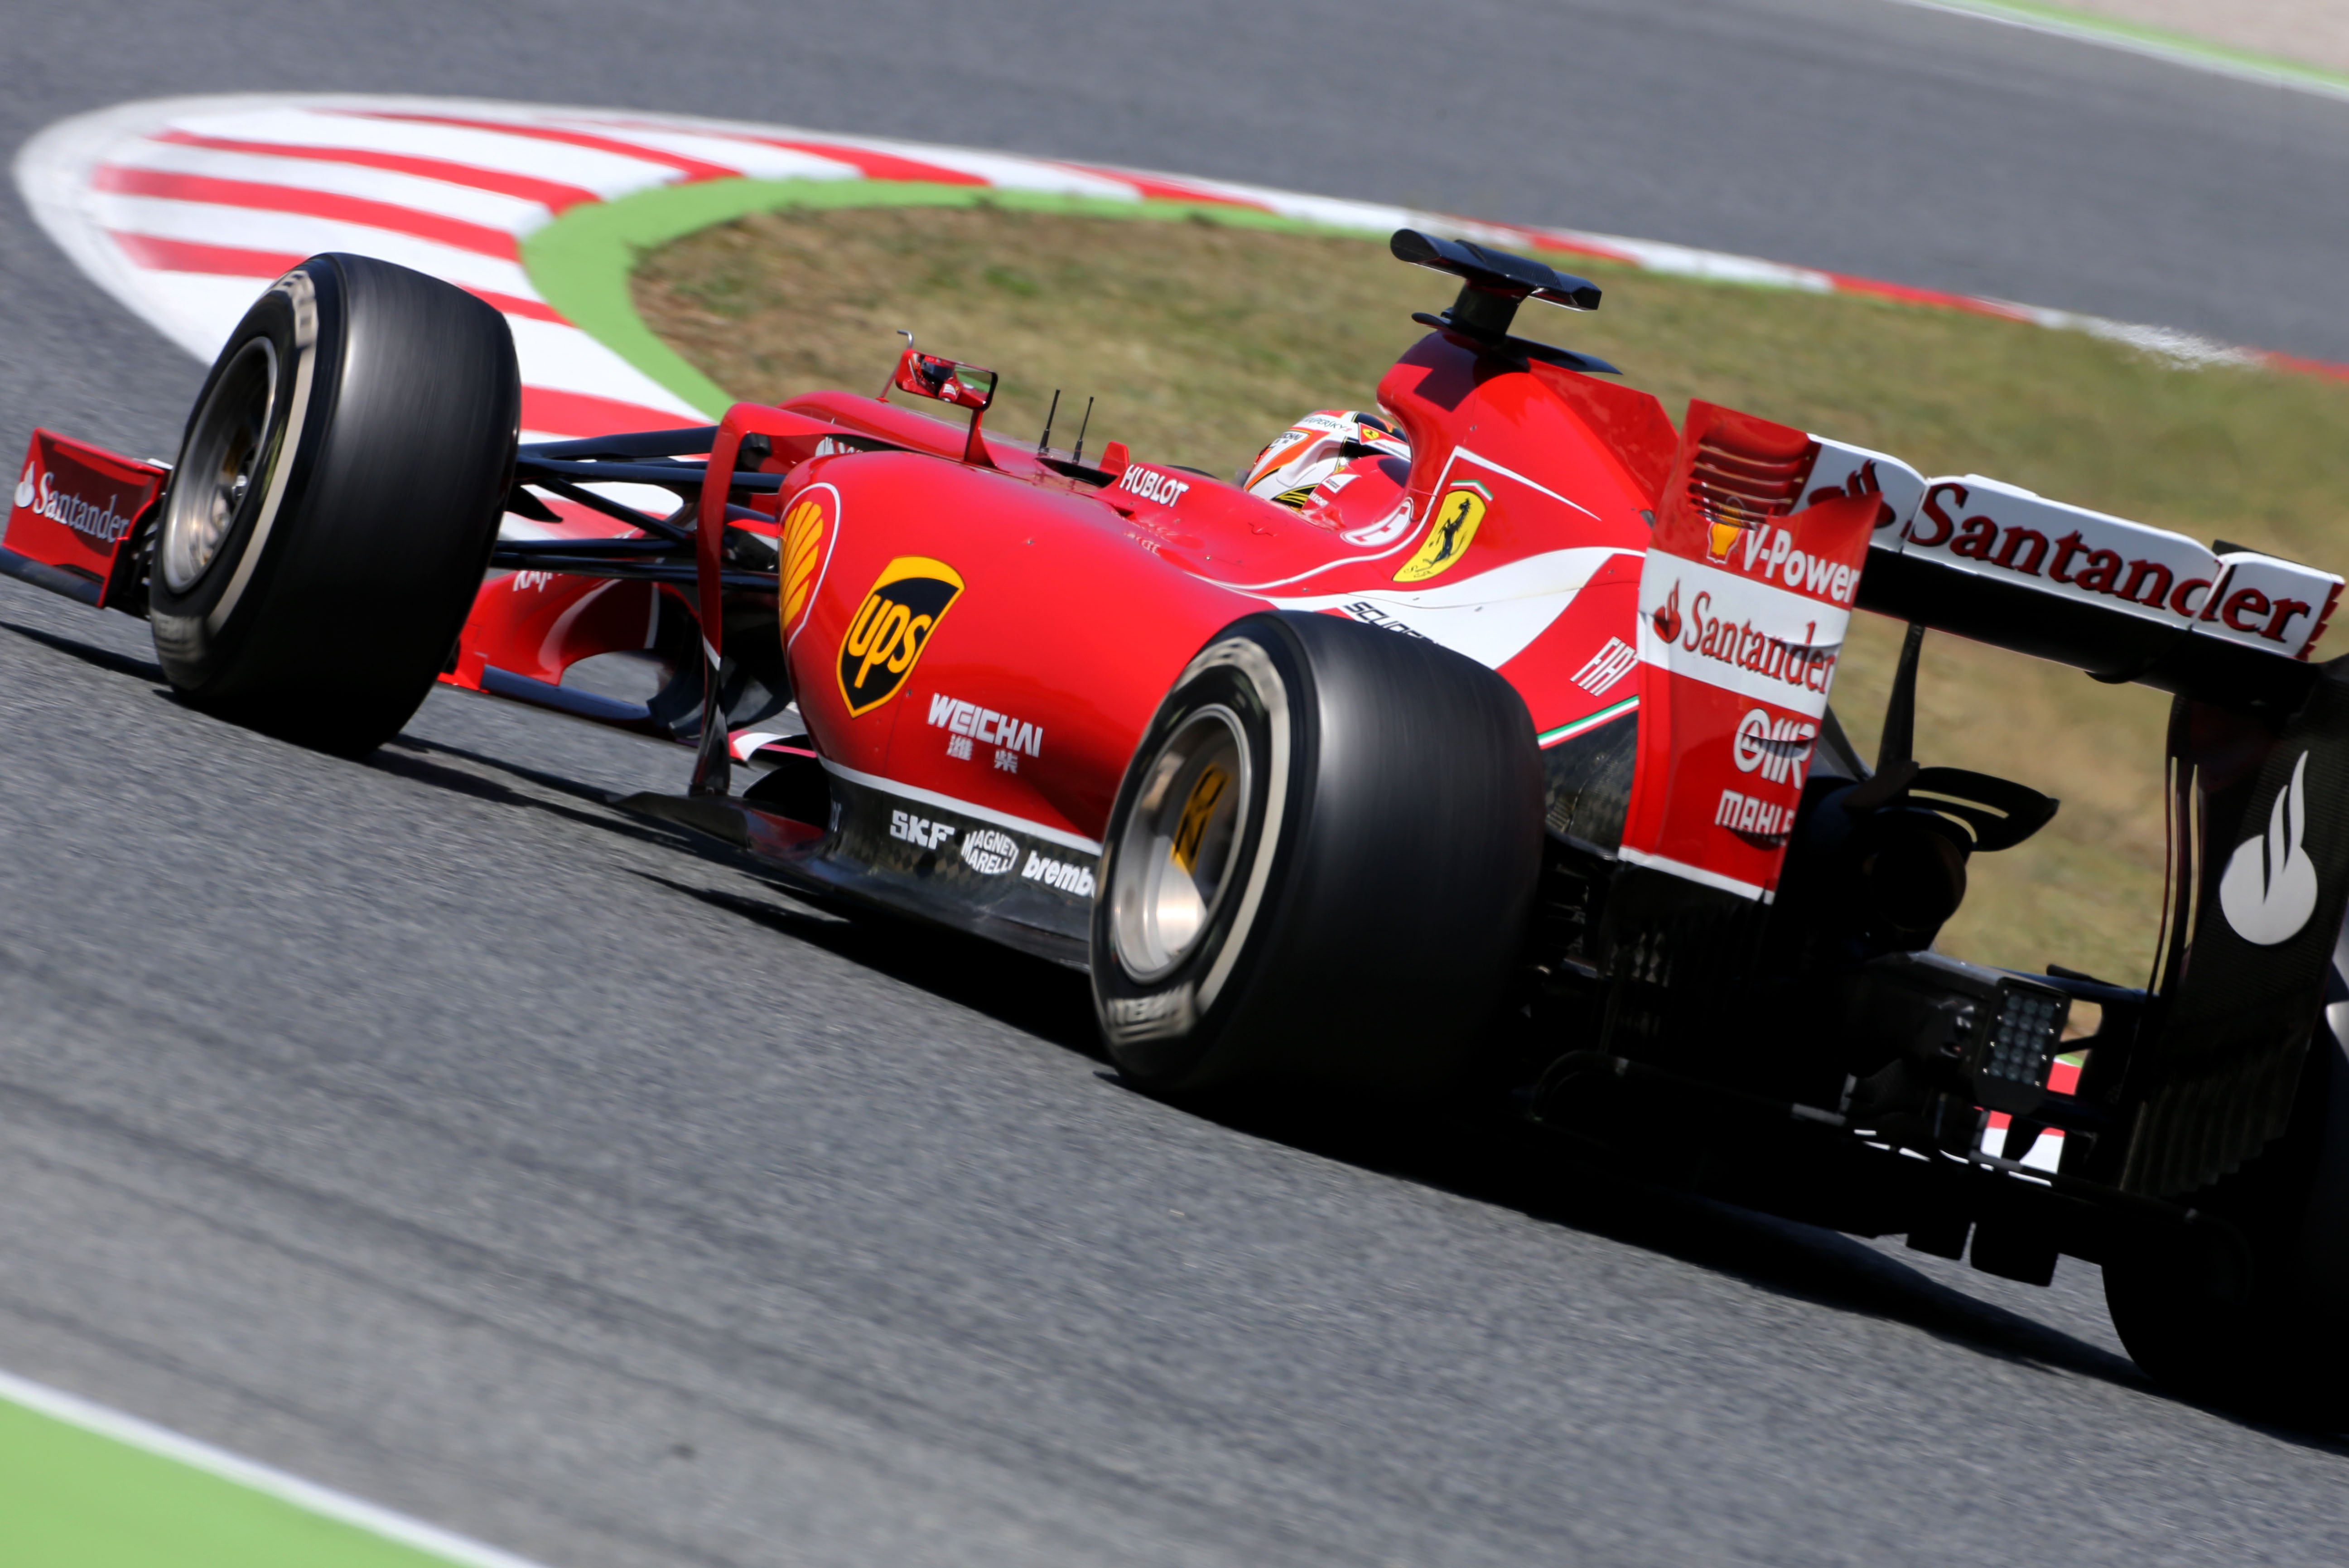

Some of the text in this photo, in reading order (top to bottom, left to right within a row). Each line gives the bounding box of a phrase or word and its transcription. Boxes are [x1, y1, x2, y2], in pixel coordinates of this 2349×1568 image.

[33, 471, 130, 543] Santander
[1119, 464, 1190, 508] HUBLOT
[1742, 524, 1861, 604] V-Power
[1900, 482, 2310, 643] Santander
[848, 594, 932, 689] ups
[1569, 636, 1639, 696] FIAT
[1682, 591, 1835, 695] Santander
[927, 692, 1043, 758] WEICHAI
[890, 810, 955, 850] SKF
